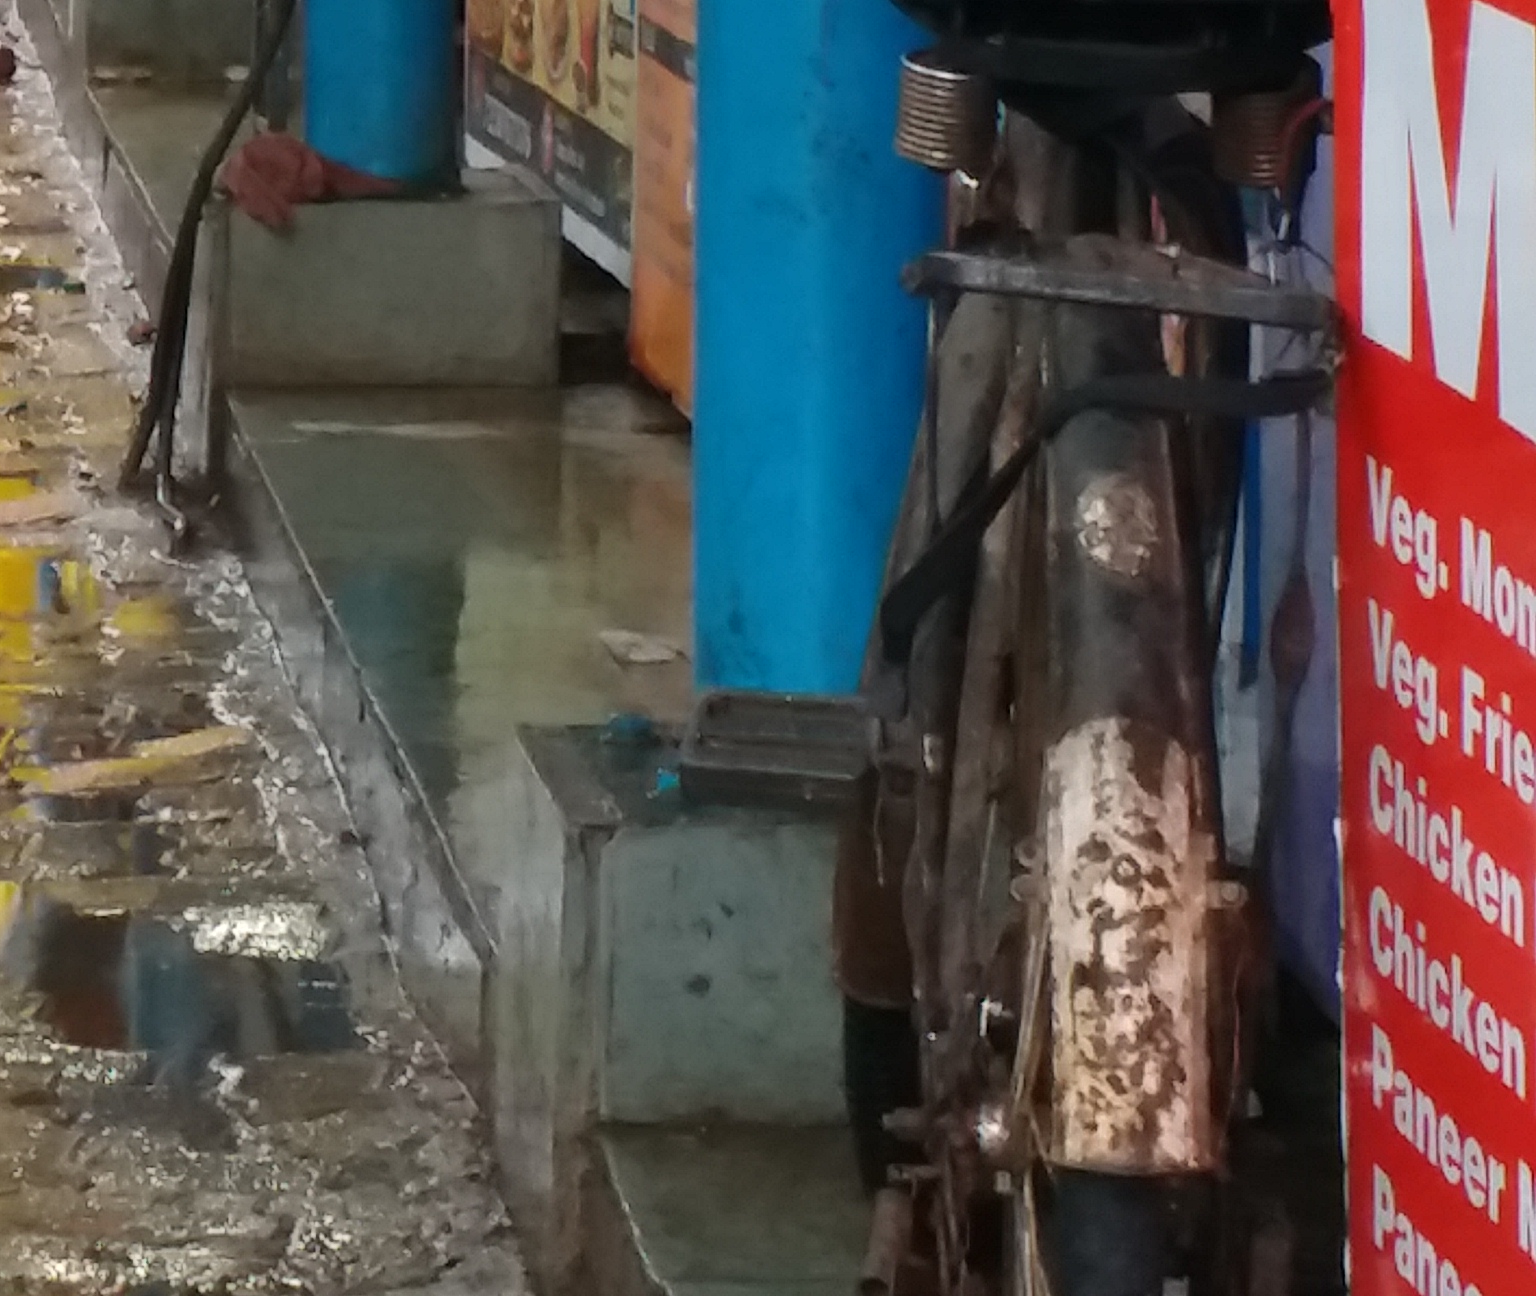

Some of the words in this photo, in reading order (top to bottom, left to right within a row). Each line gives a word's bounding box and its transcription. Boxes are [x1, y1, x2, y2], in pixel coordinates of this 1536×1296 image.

[1366, 454, 1449, 600] Veg.
[1368, 597, 1449, 746] Veg.
[1368, 743, 1525, 948] Chicken
[1368, 884, 1526, 1101] Chicken
[1370, 1021, 1506, 1225] Paneer
[1371, 1161, 1483, 1296] Pane
